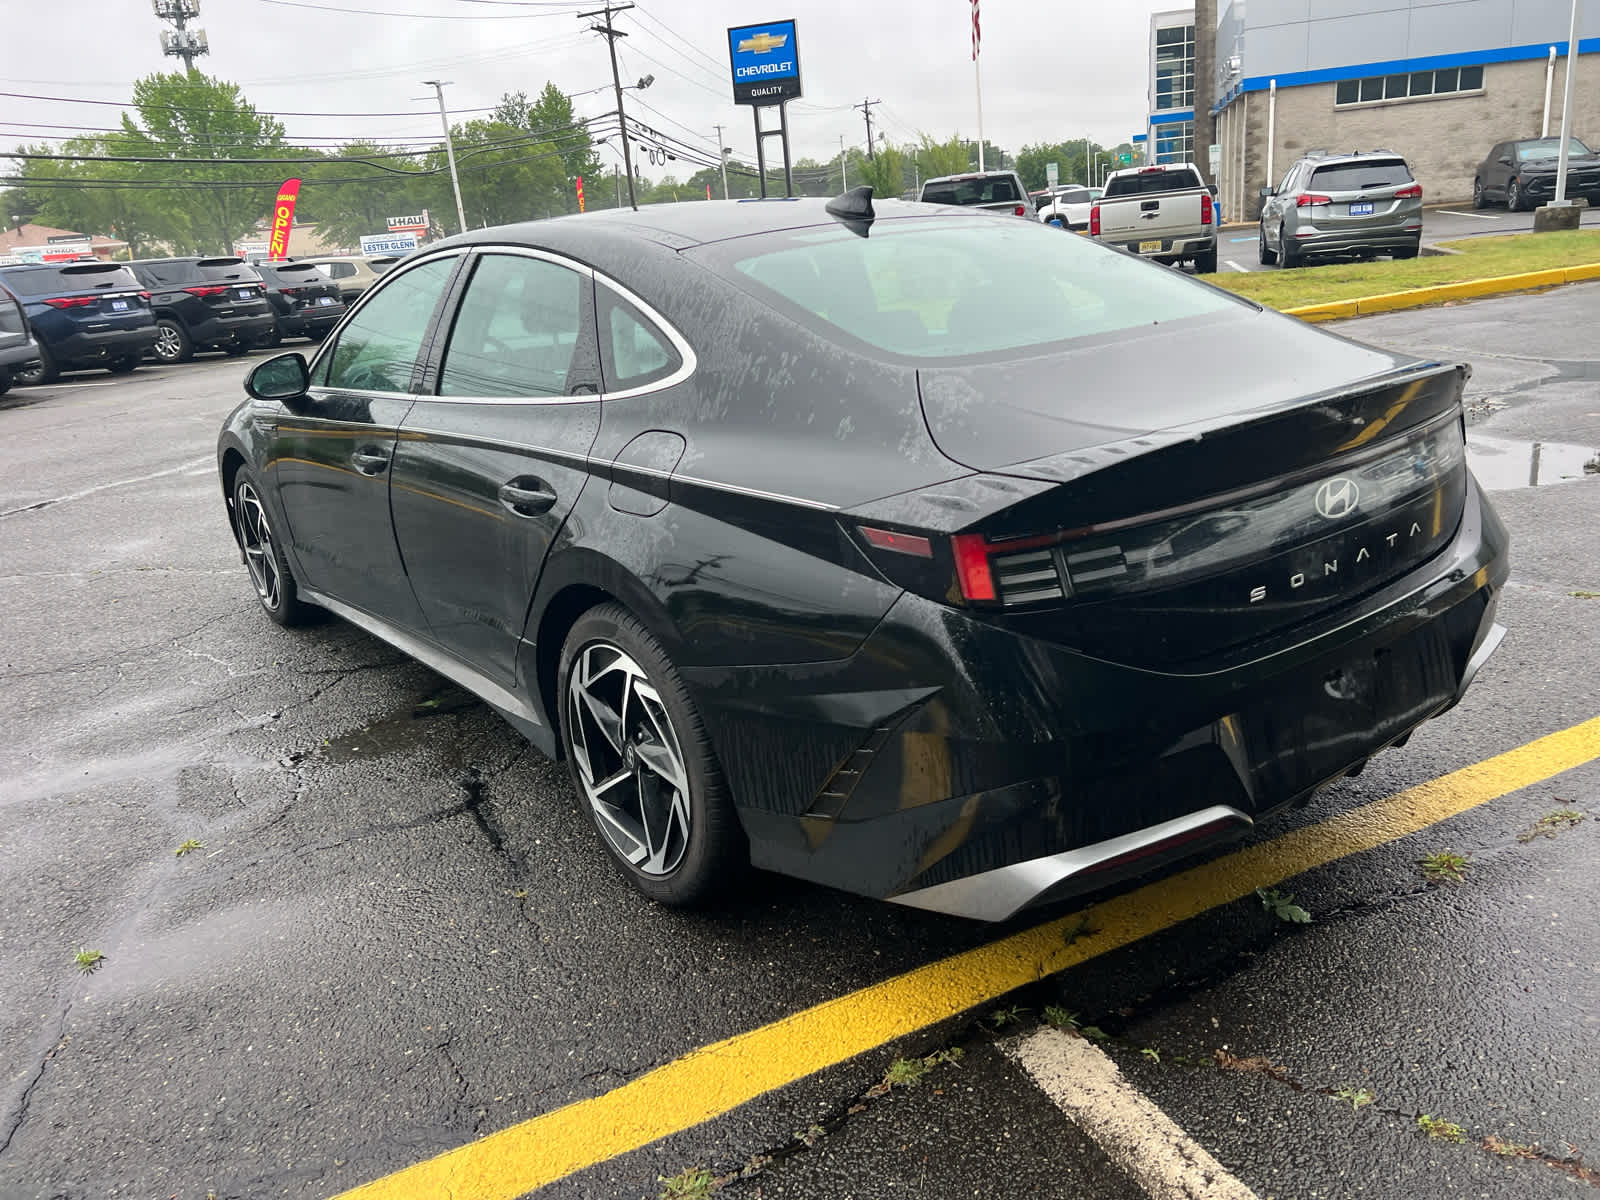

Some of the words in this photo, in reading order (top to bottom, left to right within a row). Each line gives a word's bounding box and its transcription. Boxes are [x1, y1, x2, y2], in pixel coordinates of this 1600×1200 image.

[736, 61, 792, 77] CHEVROLET
[751, 86, 782, 97] QUALITY
[363, 243, 389, 252] LESTER
[391, 241, 415, 249] GLENN
[1250, 522, 1421, 603] SONATA
